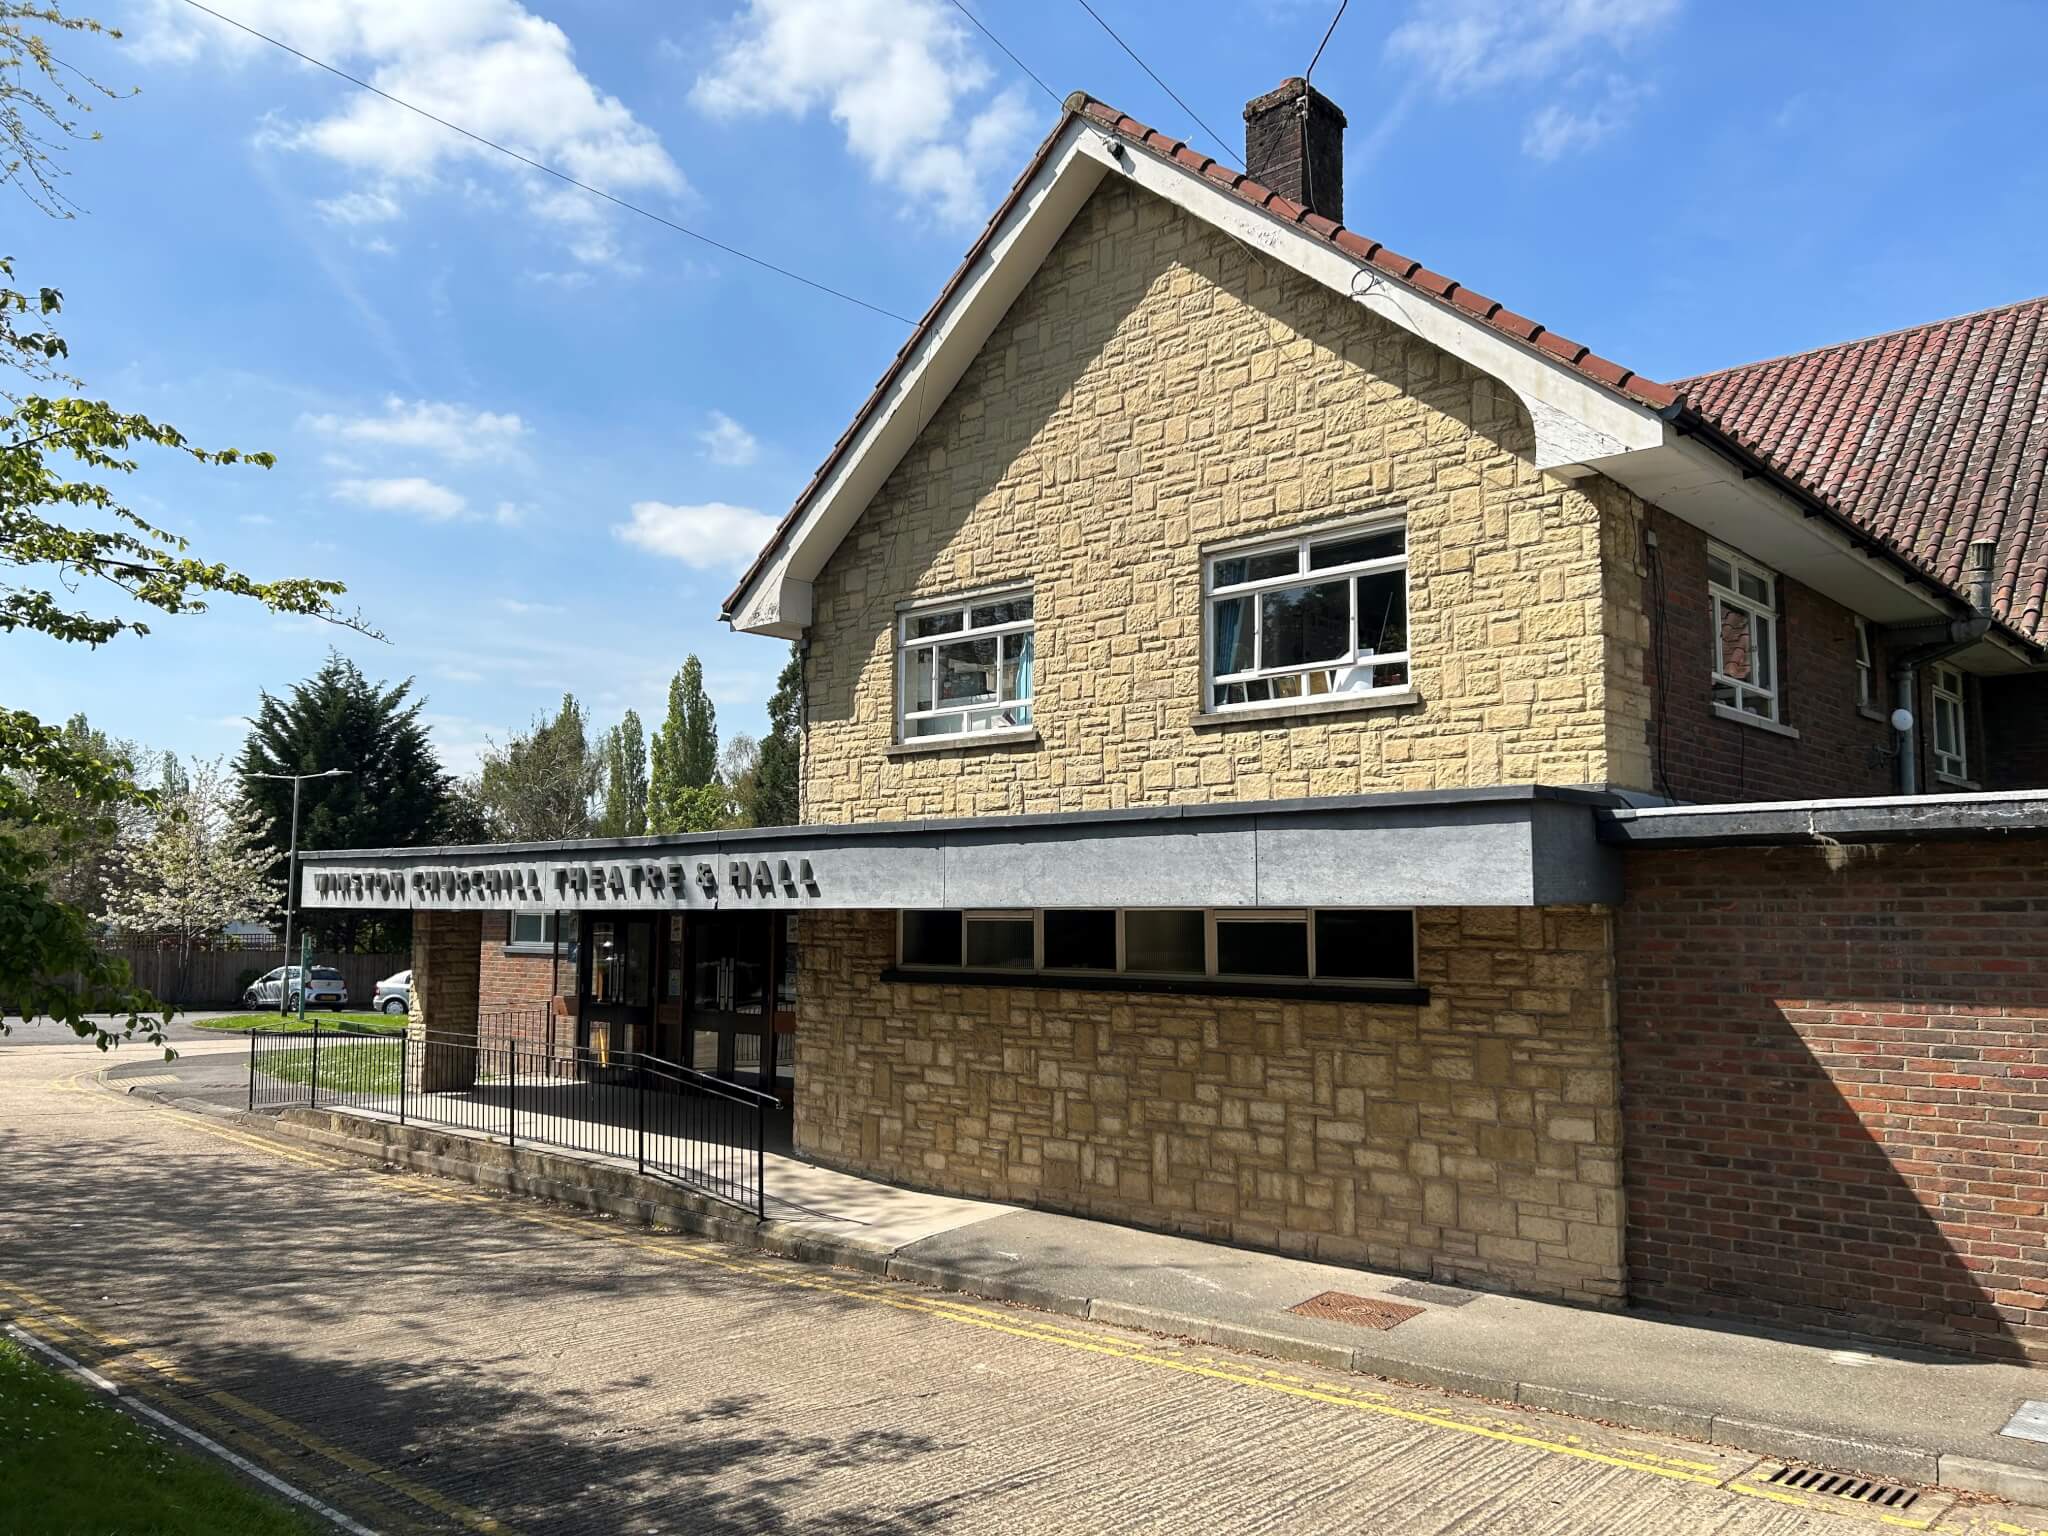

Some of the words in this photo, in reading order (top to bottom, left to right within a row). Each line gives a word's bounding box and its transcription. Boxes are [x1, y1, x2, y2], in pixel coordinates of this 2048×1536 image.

[313, 872, 404, 892] WINSTON
[412, 868, 540, 890] CHURCHILL
[551, 863, 686, 889] THEATRE
[696, 861, 714, 888] &
[728, 858, 817, 886] HALL
